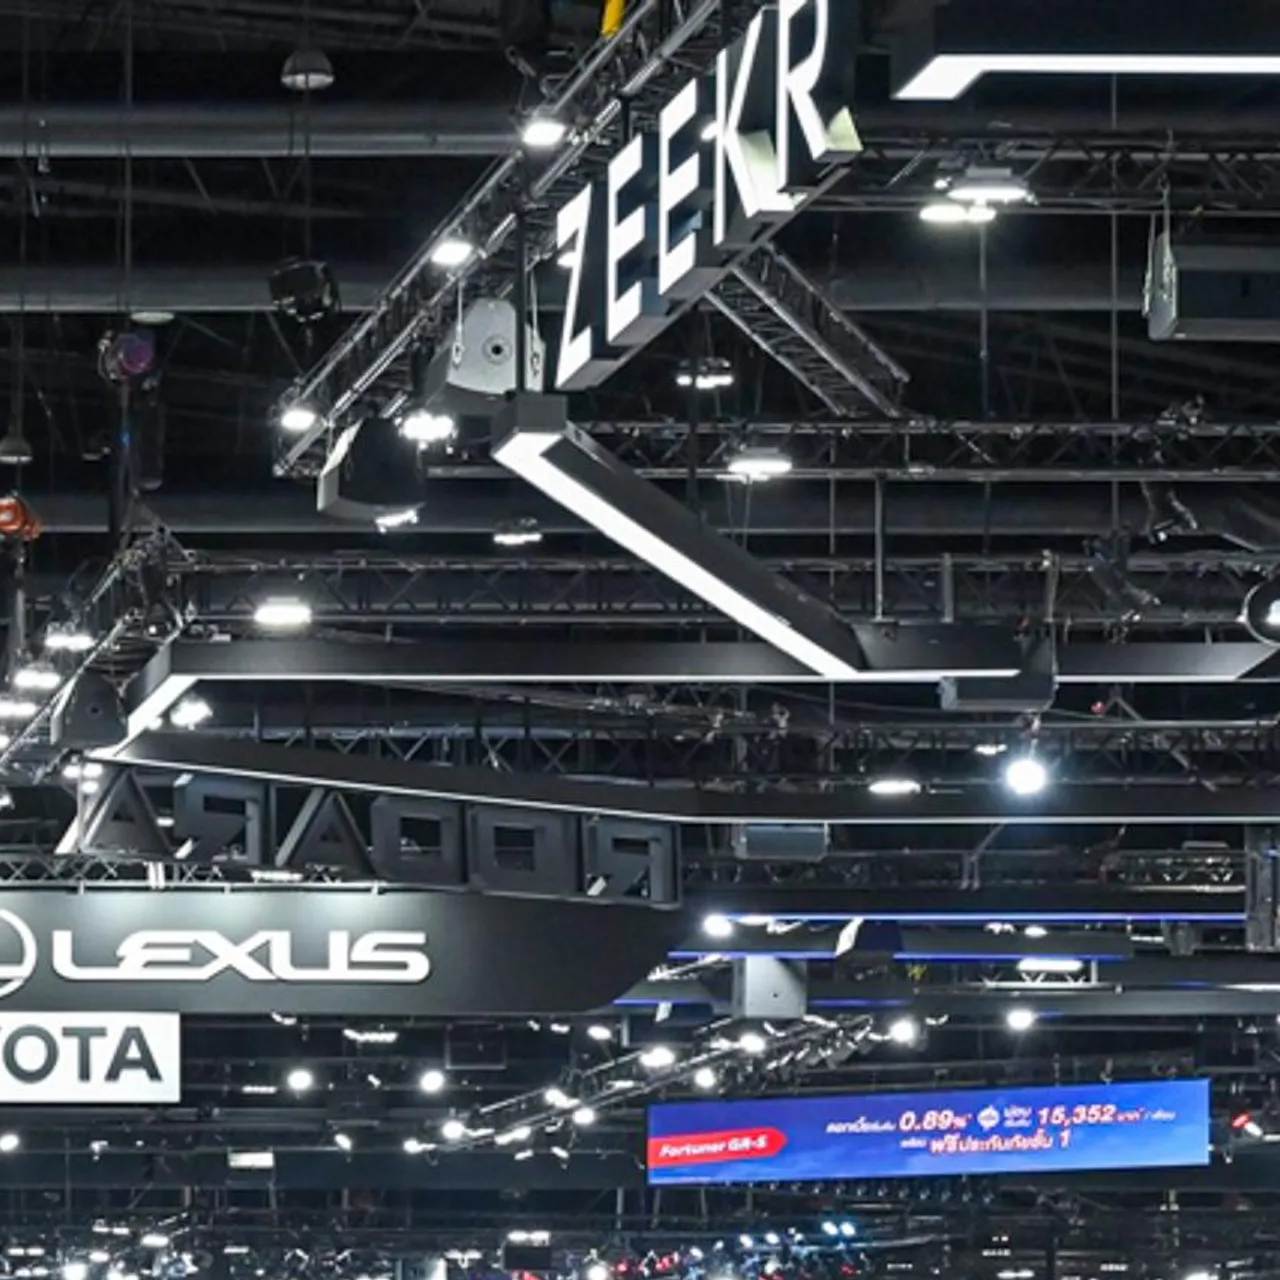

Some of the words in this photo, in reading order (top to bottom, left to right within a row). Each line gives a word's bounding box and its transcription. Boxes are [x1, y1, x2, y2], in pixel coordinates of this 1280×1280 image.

[555, 0, 852, 388] ZEEKR
[52, 930, 430, 981] LEXUS
[659, 1142, 726, 1158] Fortuner
